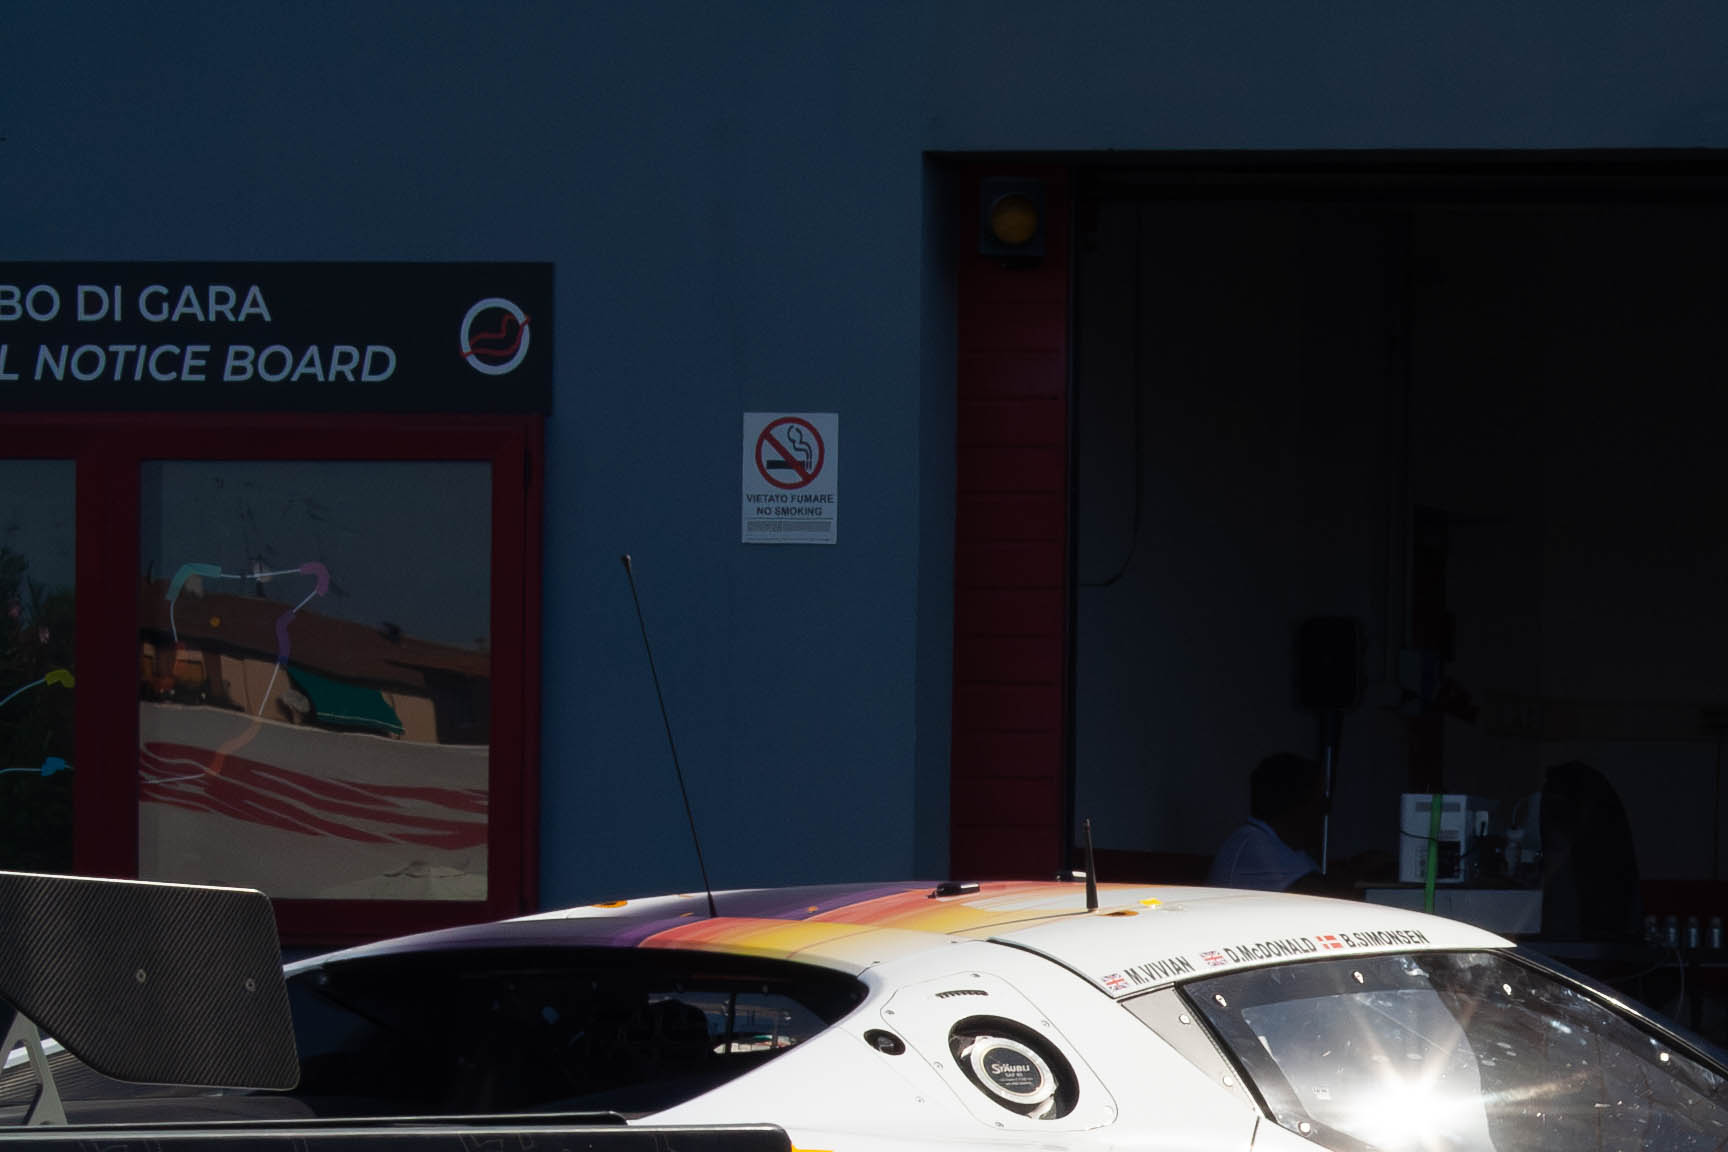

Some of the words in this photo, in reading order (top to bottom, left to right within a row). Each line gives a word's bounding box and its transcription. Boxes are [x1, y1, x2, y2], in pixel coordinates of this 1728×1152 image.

[76, 284, 122, 322] DI
[138, 284, 272, 322] GARA
[34, 344, 212, 382] NOTICE
[223, 344, 398, 383] BOARD
[746, 494, 788, 504] VIETATO
[791, 494, 834, 504] FUMARE
[756, 506, 773, 516] NO
[775, 506, 823, 517] SMOKING
[1124, 955, 1196, 985] M.VIVIAN
[1340, 930, 1431, 948] B.SIMONSEN
